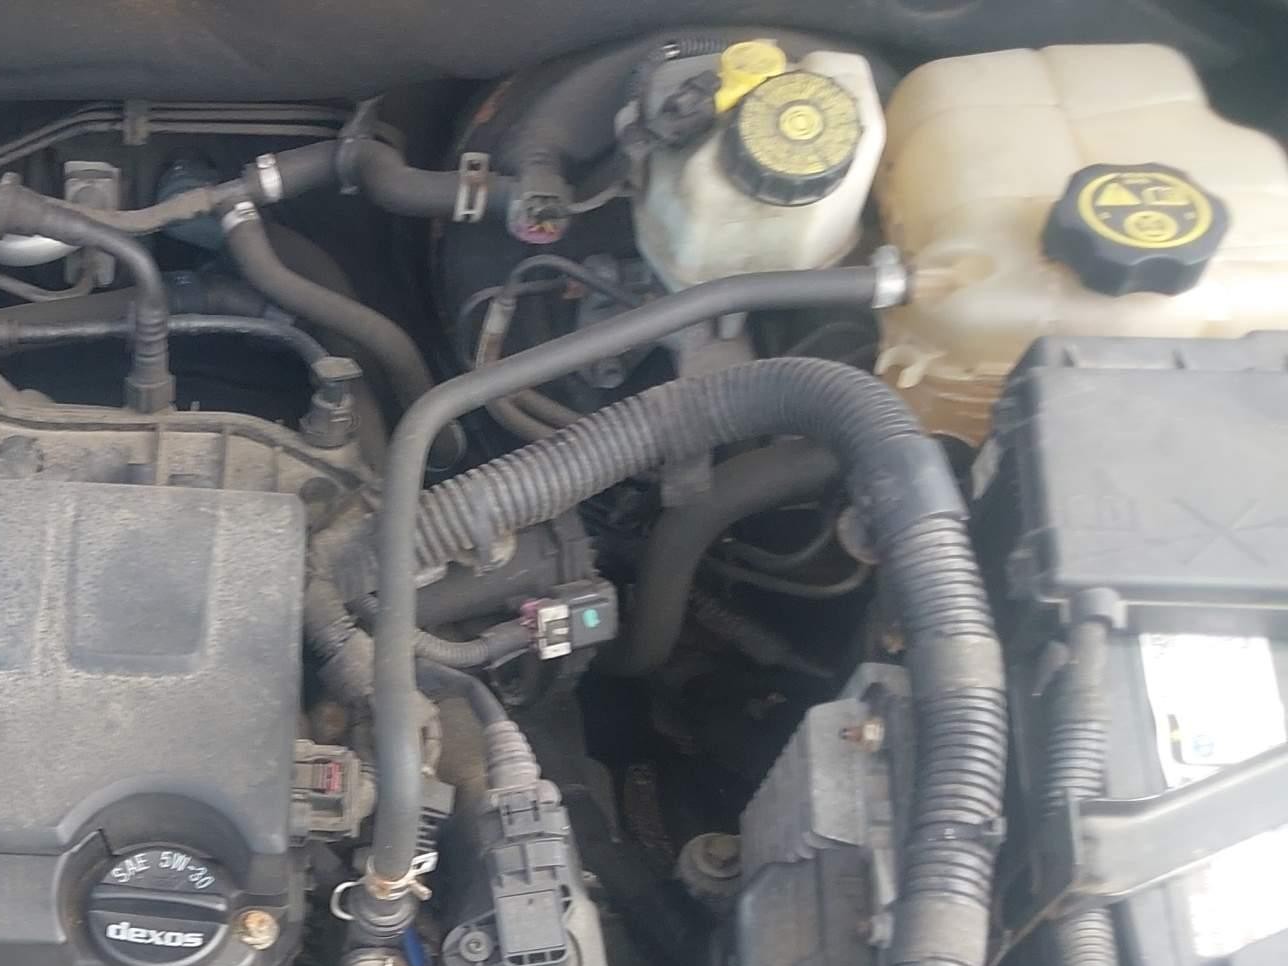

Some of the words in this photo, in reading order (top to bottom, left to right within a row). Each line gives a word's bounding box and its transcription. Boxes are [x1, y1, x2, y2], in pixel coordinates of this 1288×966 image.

[112, 853, 151, 883] SAE
[159, 851, 215, 889] 5W-30
[106, 921, 204, 947] dexos
